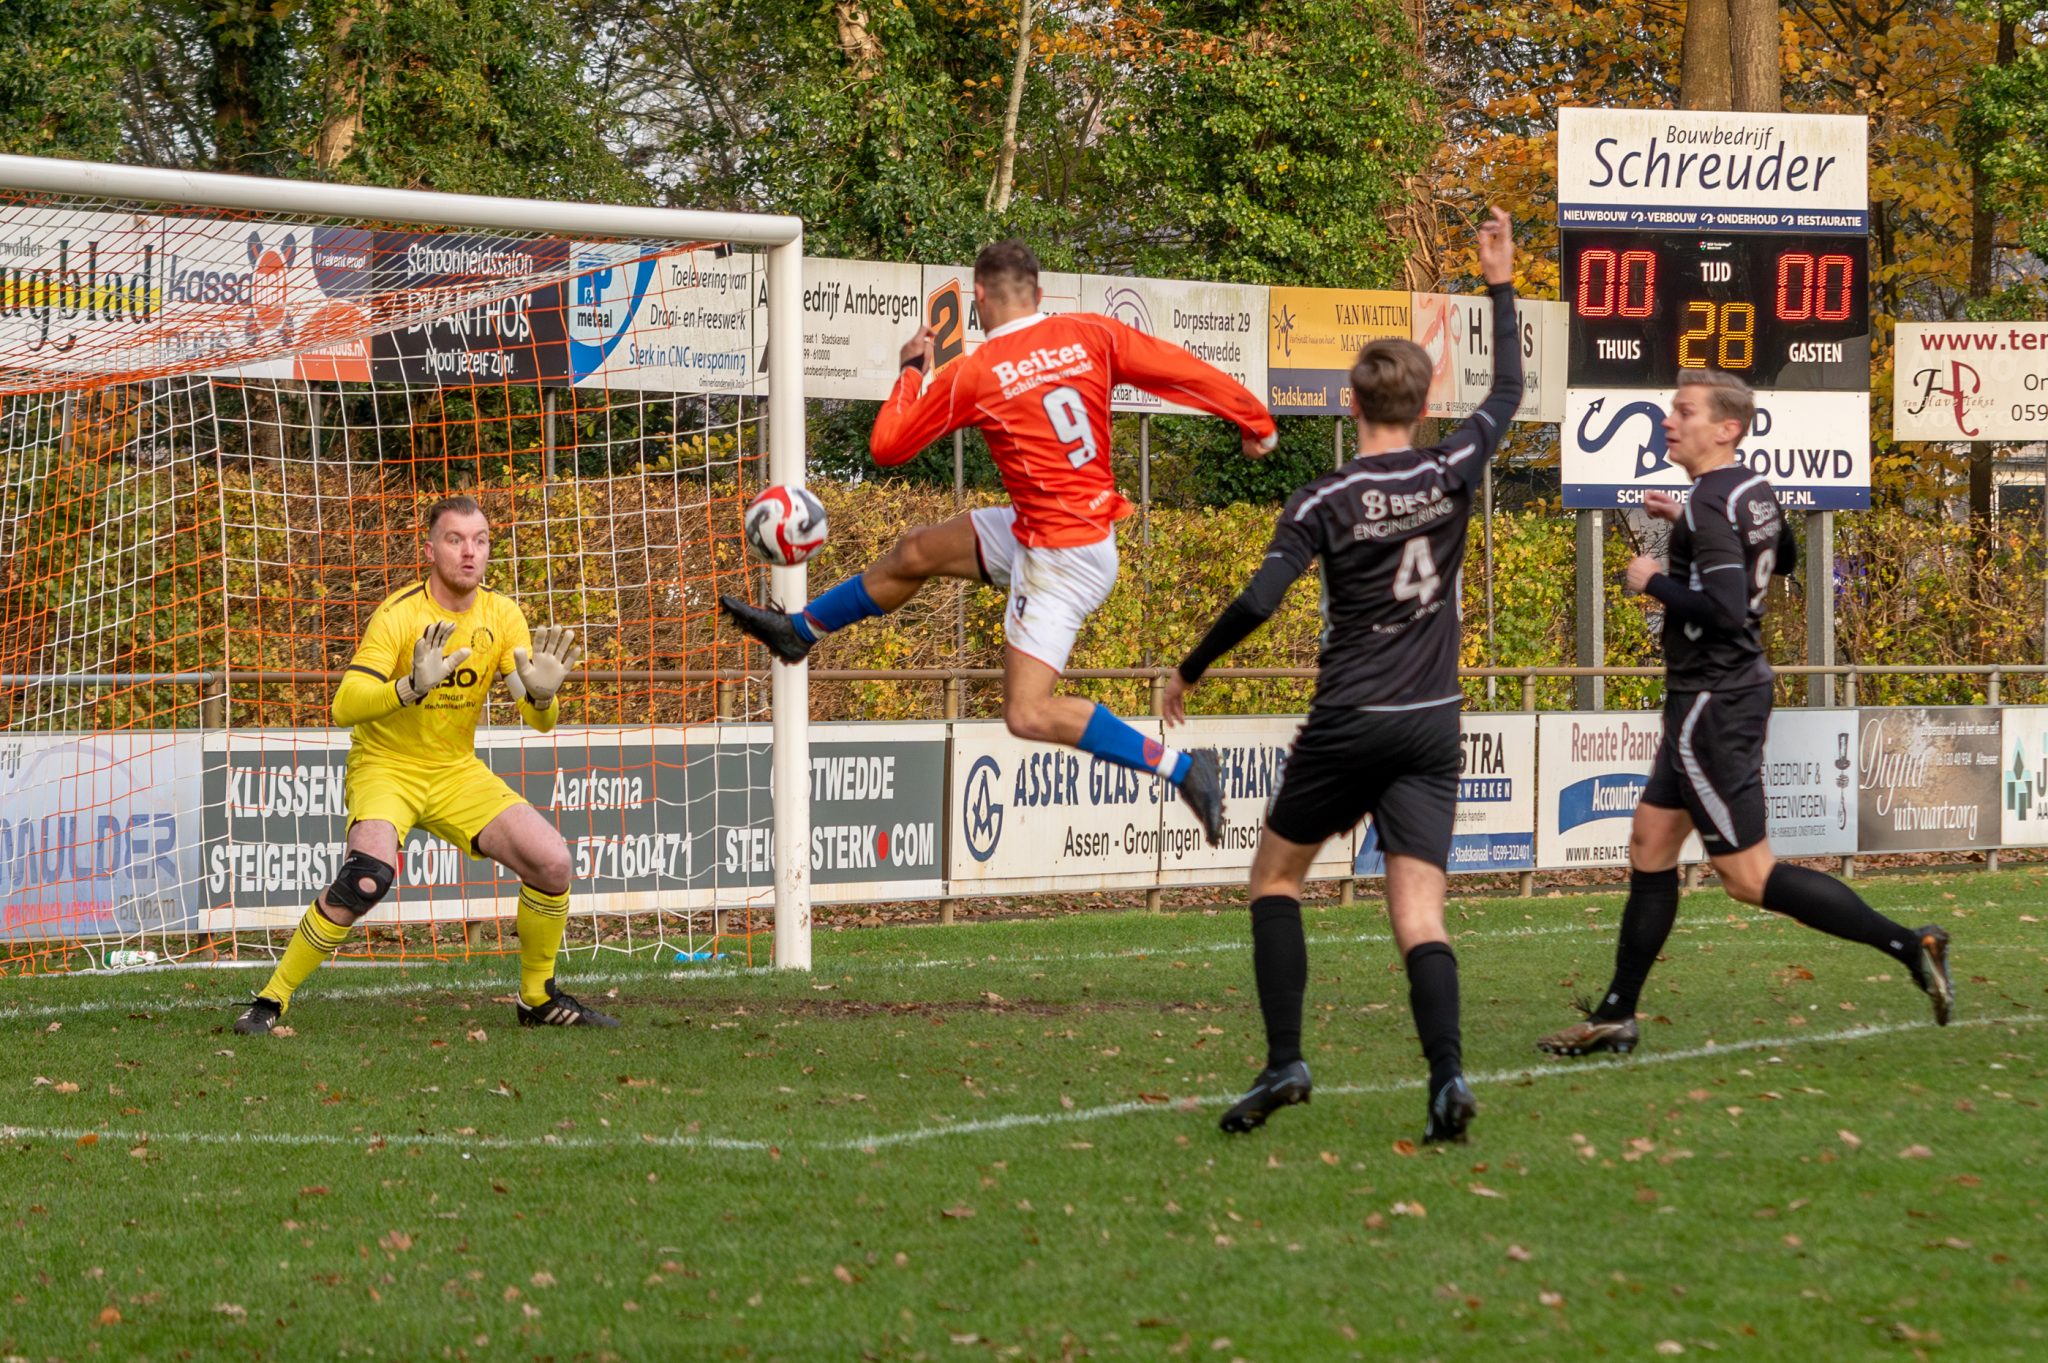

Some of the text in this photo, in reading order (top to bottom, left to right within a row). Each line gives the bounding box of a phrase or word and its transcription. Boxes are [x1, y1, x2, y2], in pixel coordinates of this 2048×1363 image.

[1666, 125, 1774, 150] Bouwbedrijf
[1589, 137, 1835, 191] Schreuder
[1563, 210, 1861, 227] NIEUWBOUW VERBOUW ONDERHOUD RESTAURATIE
[407, 242, 533, 279] Schoonheidssalon
[671, 264, 747, 294] Toelevering van
[1701, 261, 1732, 282] TIJD
[1578, 250, 1656, 317] 00
[1776, 254, 1853, 320] 00
[577, 309, 613, 329] metaal
[683, 313, 695, 328] en
[697, 308, 747, 330] Freeswerk
[843, 283, 918, 324] Ambergen
[1173, 309, 1250, 334] Dorpsstraat 29
[1336, 304, 1408, 327] VAN WATTUM
[1597, 339, 1641, 359] THUIS
[1679, 301, 1756, 369] 28
[1788, 343, 1843, 363] GASTEN
[629, 343, 746, 376] Sterk in CNC verspaning
[992, 343, 1087, 388] Beikes
[1271, 386, 1328, 406] Stadskanaal
[1042, 385, 1097, 471] 9
[1352, 497, 1454, 541] ENGINEERING
[1393, 536, 1441, 605] 4
[1571, 722, 1618, 763] Renate
[225, 765, 348, 818] KLUSSEN
[549, 768, 643, 812] Aartsma
[1013, 750, 1079, 808] ASSER
[1893, 800, 1979, 841] uitvaartzorg
[575, 832, 693, 880] 57160471
[1063, 825, 1110, 858] Assen
[1124, 822, 1200, 860] Groningen
[1455, 844, 1489, 862] Stadskanaal
